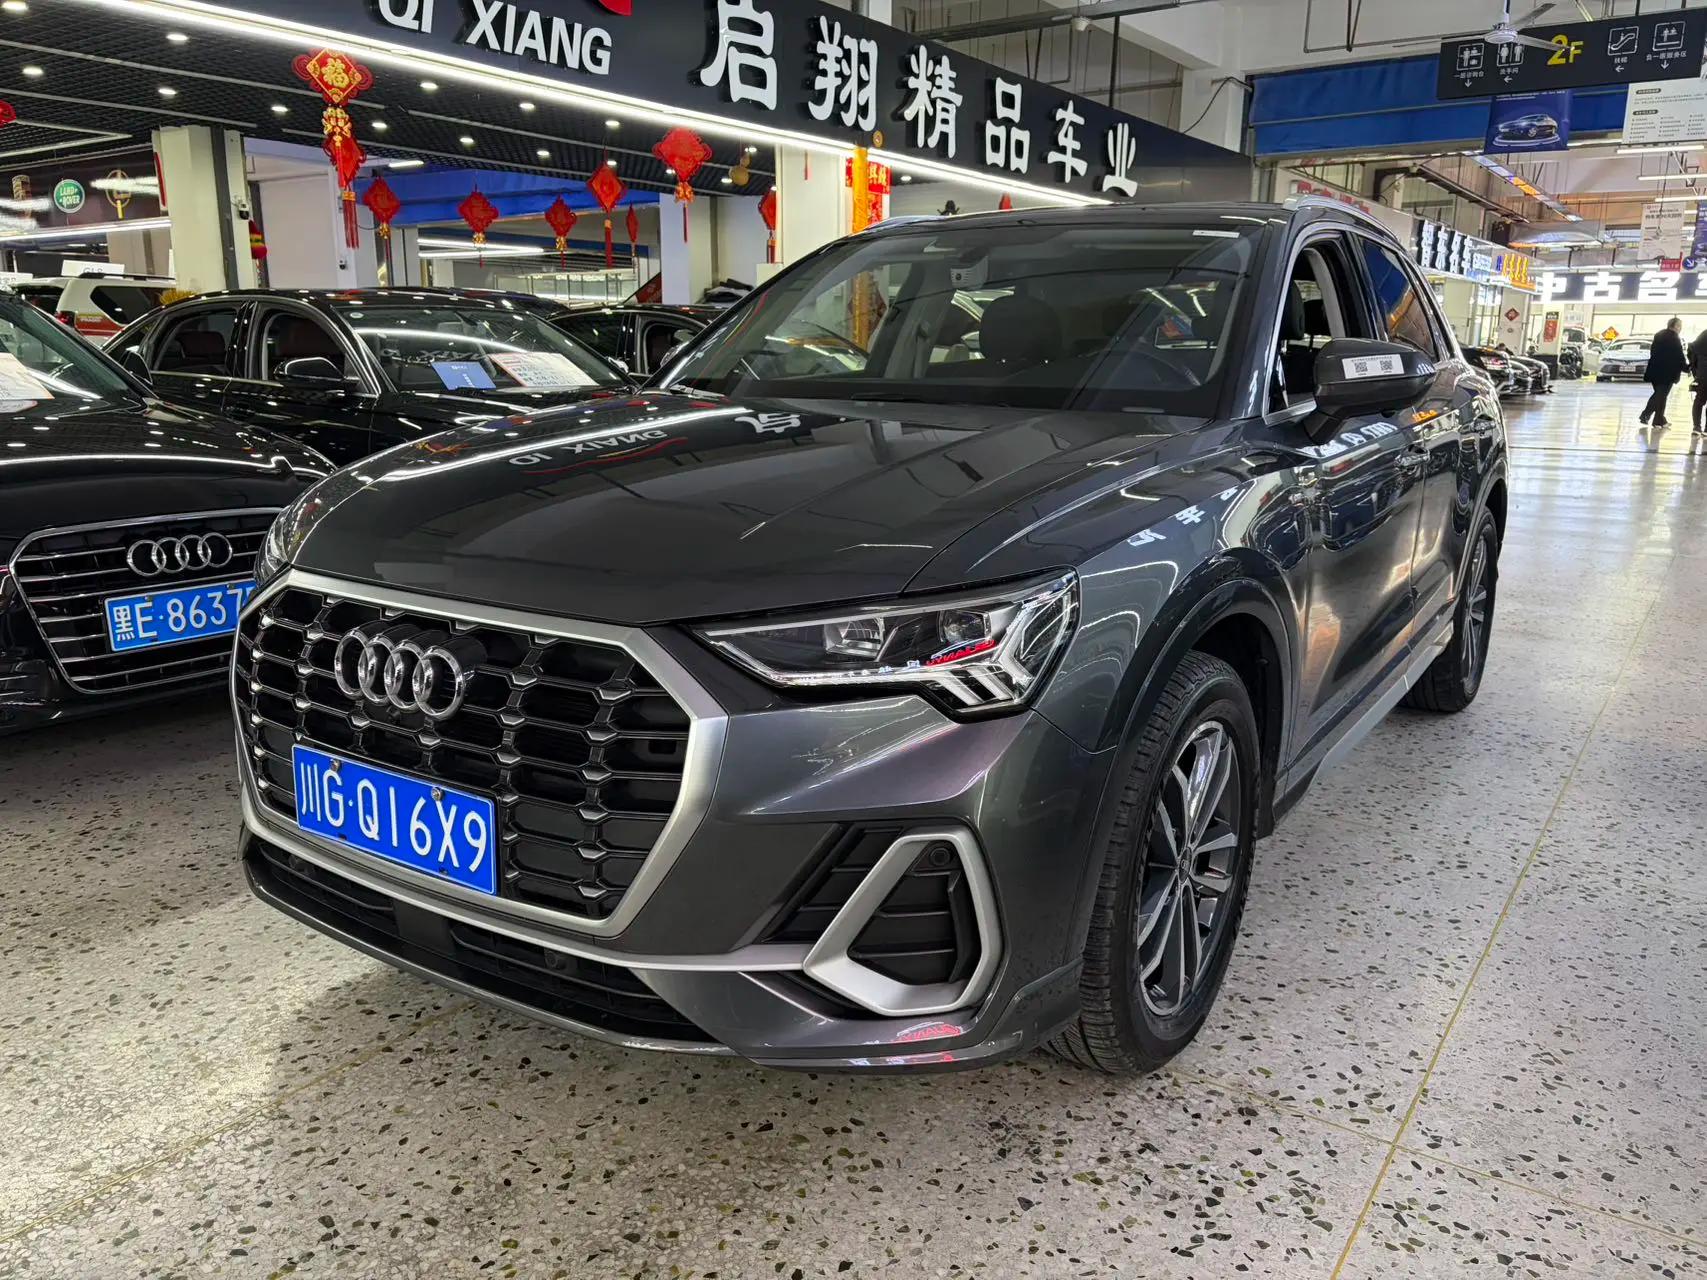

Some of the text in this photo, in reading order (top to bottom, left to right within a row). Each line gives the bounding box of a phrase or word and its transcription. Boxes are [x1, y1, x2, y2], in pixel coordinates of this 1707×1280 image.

[465, 0, 613, 76] XIANG
[1547, 34, 1584, 65] 2F
[700, 0, 1140, 198] 启翔精品车业
[113, 586, 255, 641] 黑E·8637
[300, 761, 487, 873] 川G·Q16X9
